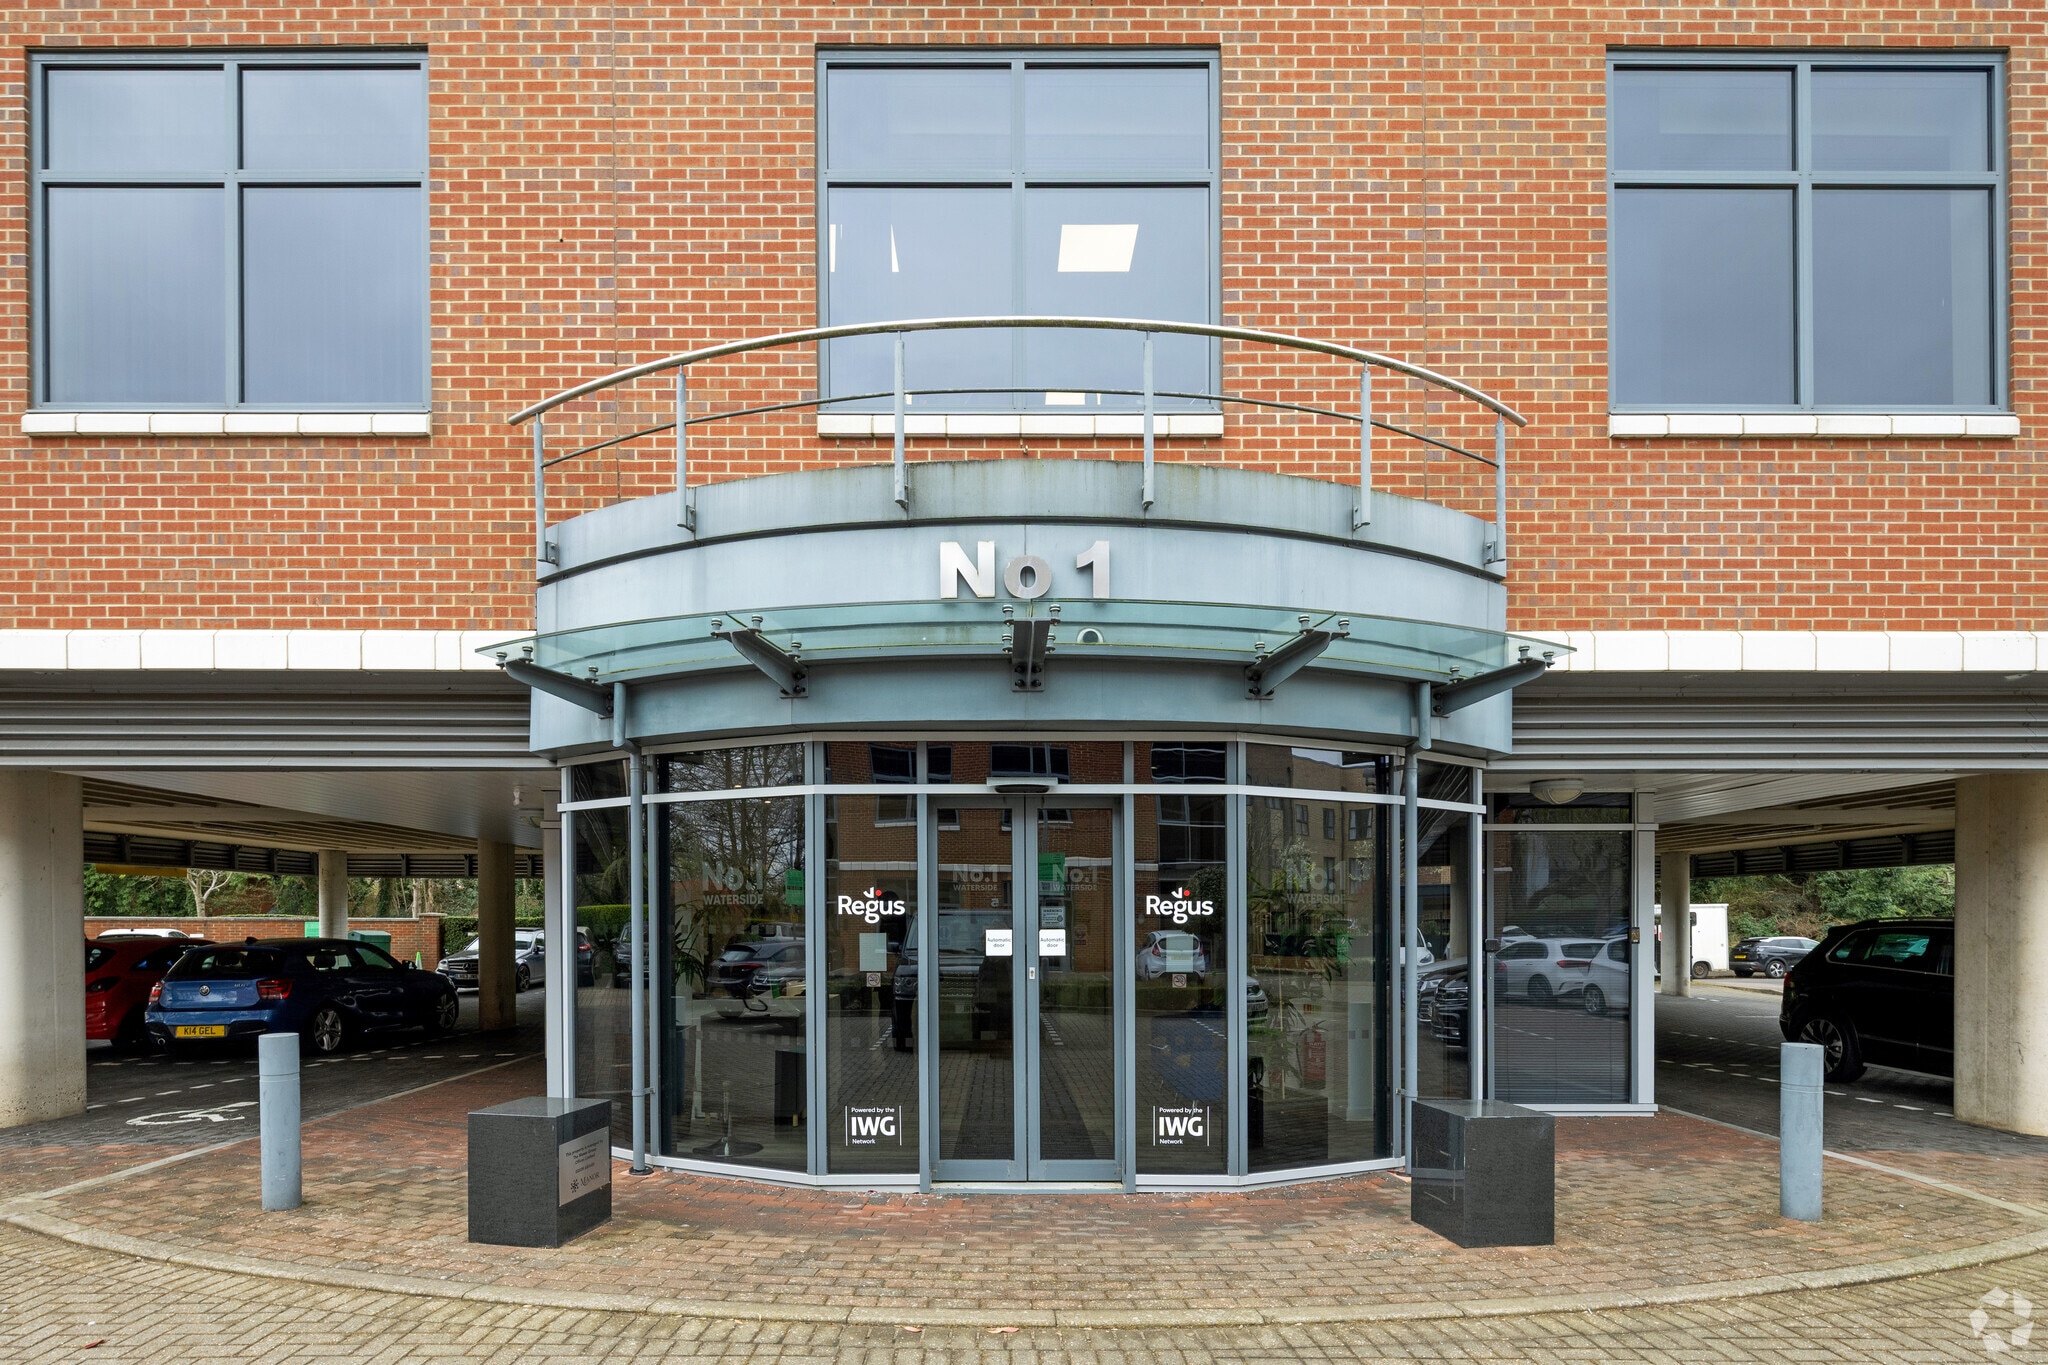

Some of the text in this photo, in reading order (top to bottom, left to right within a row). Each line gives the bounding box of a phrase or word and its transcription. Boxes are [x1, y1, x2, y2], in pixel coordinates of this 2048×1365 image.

[940, 540, 1111, 600] No 1
[701, 859, 764, 892] No.1
[952, 864, 999, 883] No.1
[1052, 864, 1098, 883] No.1
[1286, 859, 1346, 891] No.1
[1052, 884, 1098, 892] WATERSIDE
[1287, 893, 1346, 904] WATERSIDE
[703, 894, 764, 905] WATERSIDE
[837, 895, 906, 924] Regus
[1146, 895, 1214, 924] Regus
[183, 1027, 216, 1035] K14 GEL
[851, 1116, 896, 1137] IWG
[1159, 1116, 1203, 1137] IWG
